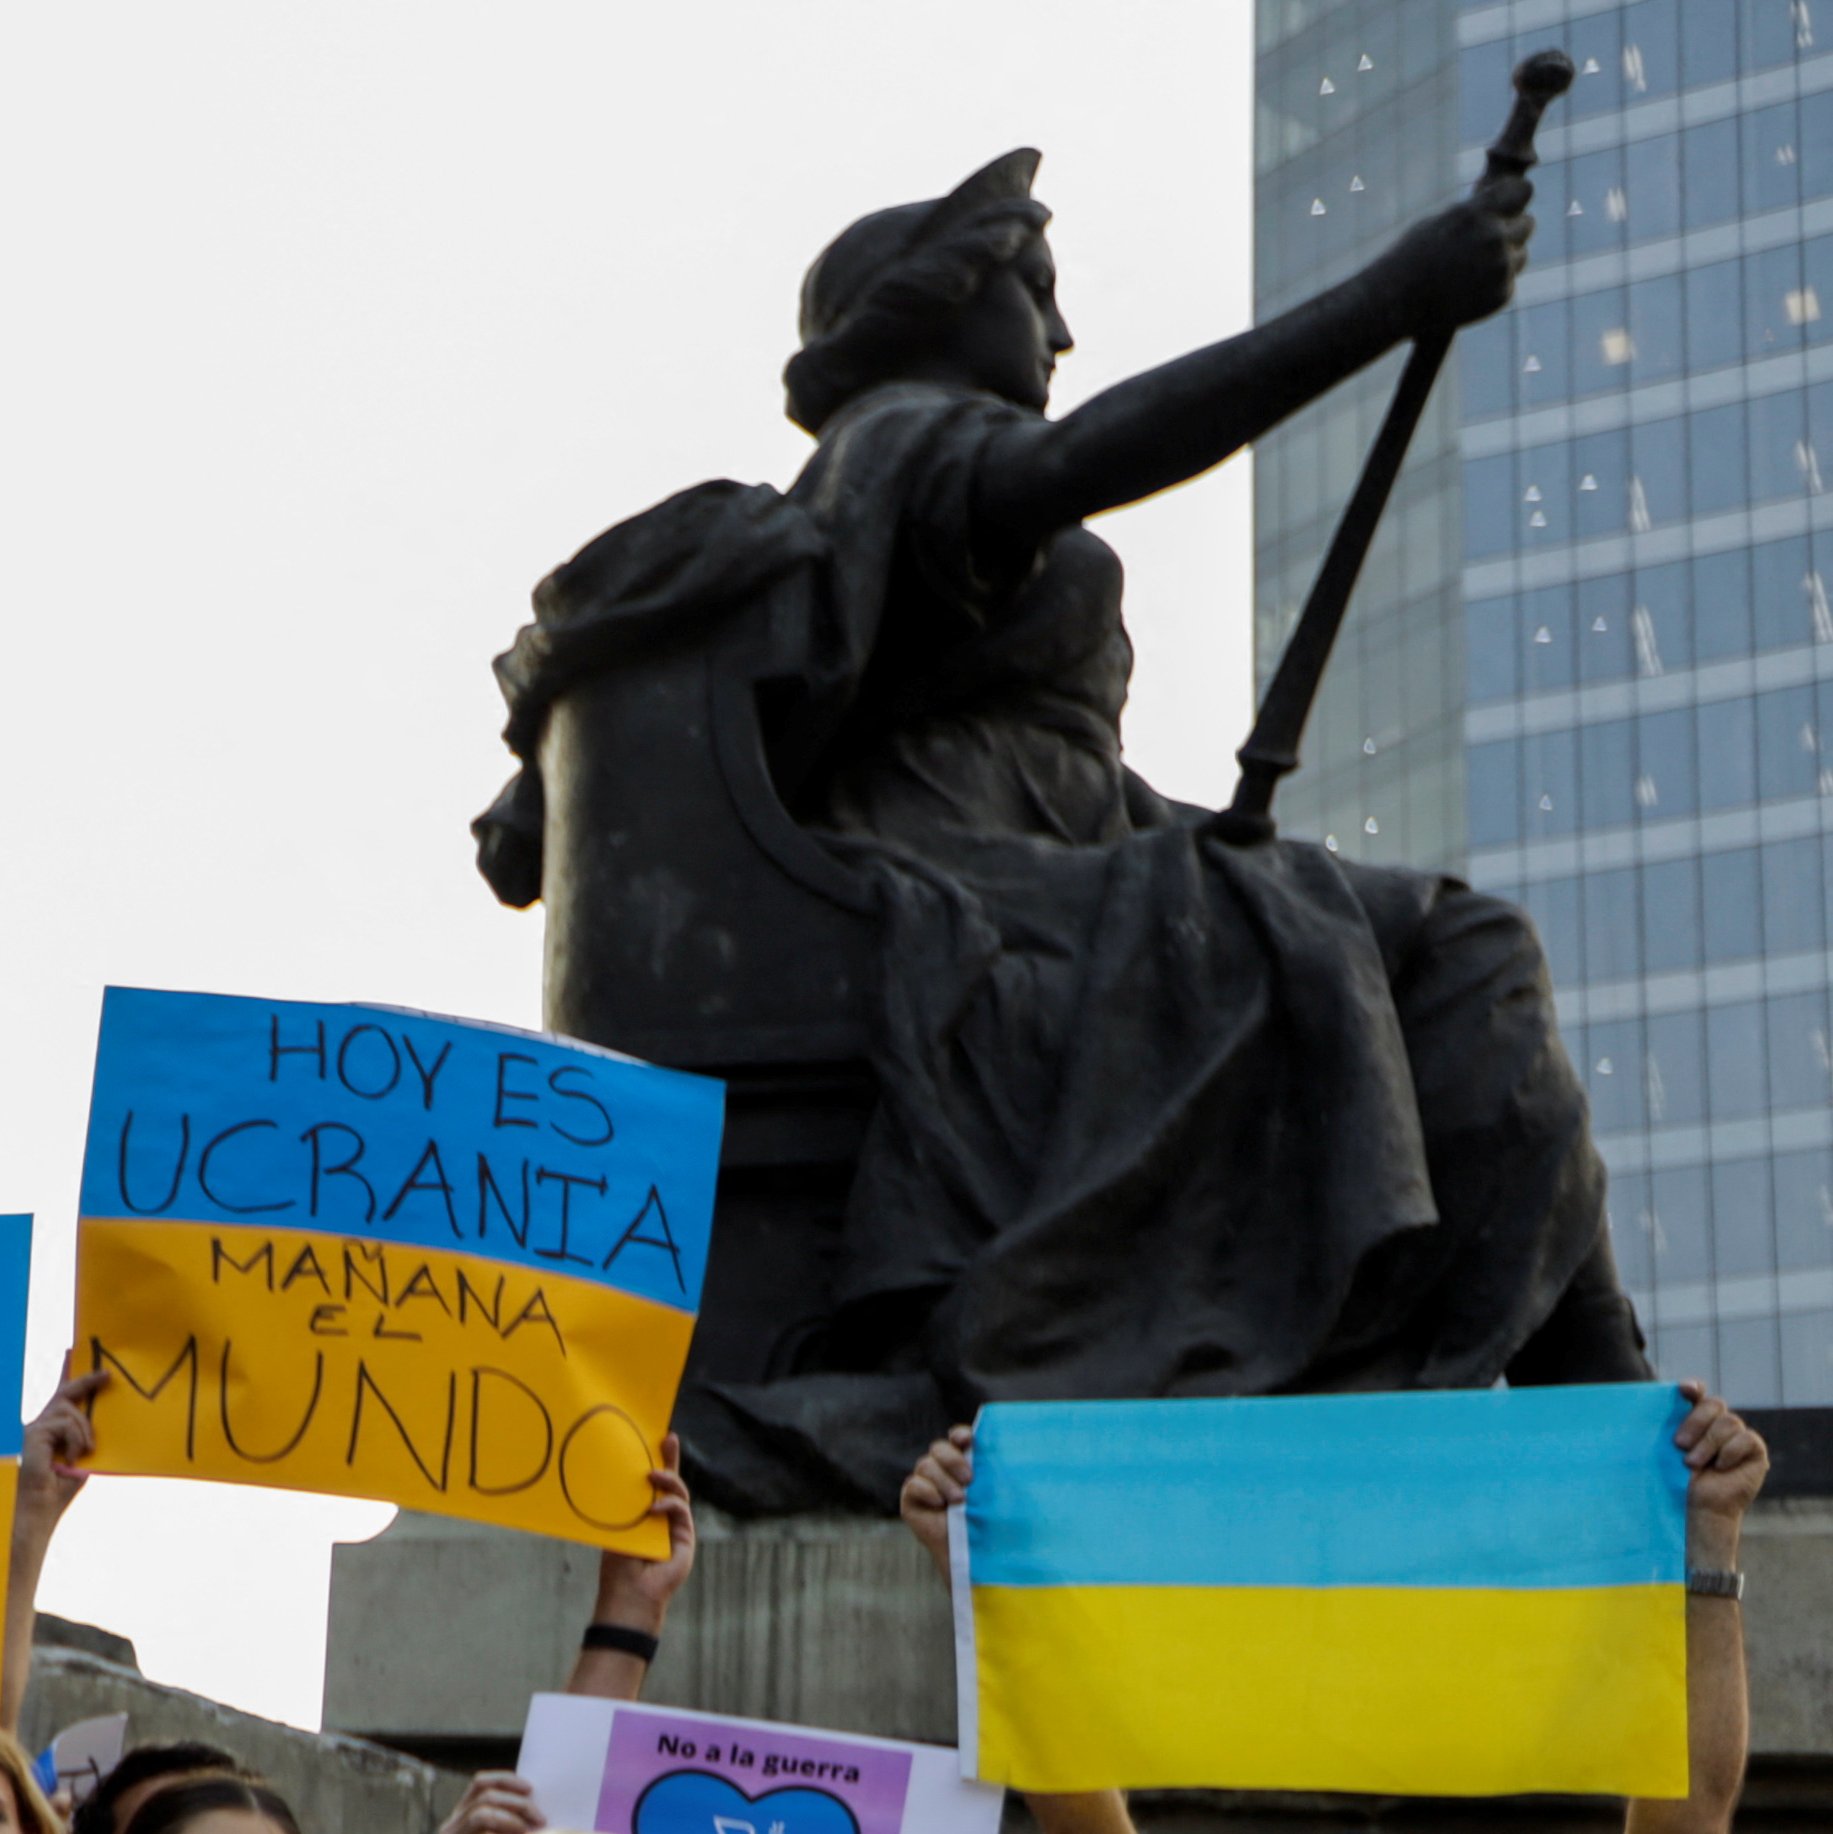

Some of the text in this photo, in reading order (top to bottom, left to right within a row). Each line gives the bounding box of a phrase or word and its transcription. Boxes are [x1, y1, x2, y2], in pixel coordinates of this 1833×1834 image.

[269, 1011, 615, 1147] HOY ES
[119, 1108, 686, 1295] UCRANIA
[309, 1304, 424, 1342] EL
[85, 1332, 658, 1532] MUNDO
[657, 1733, 861, 1784] No a la guerra
